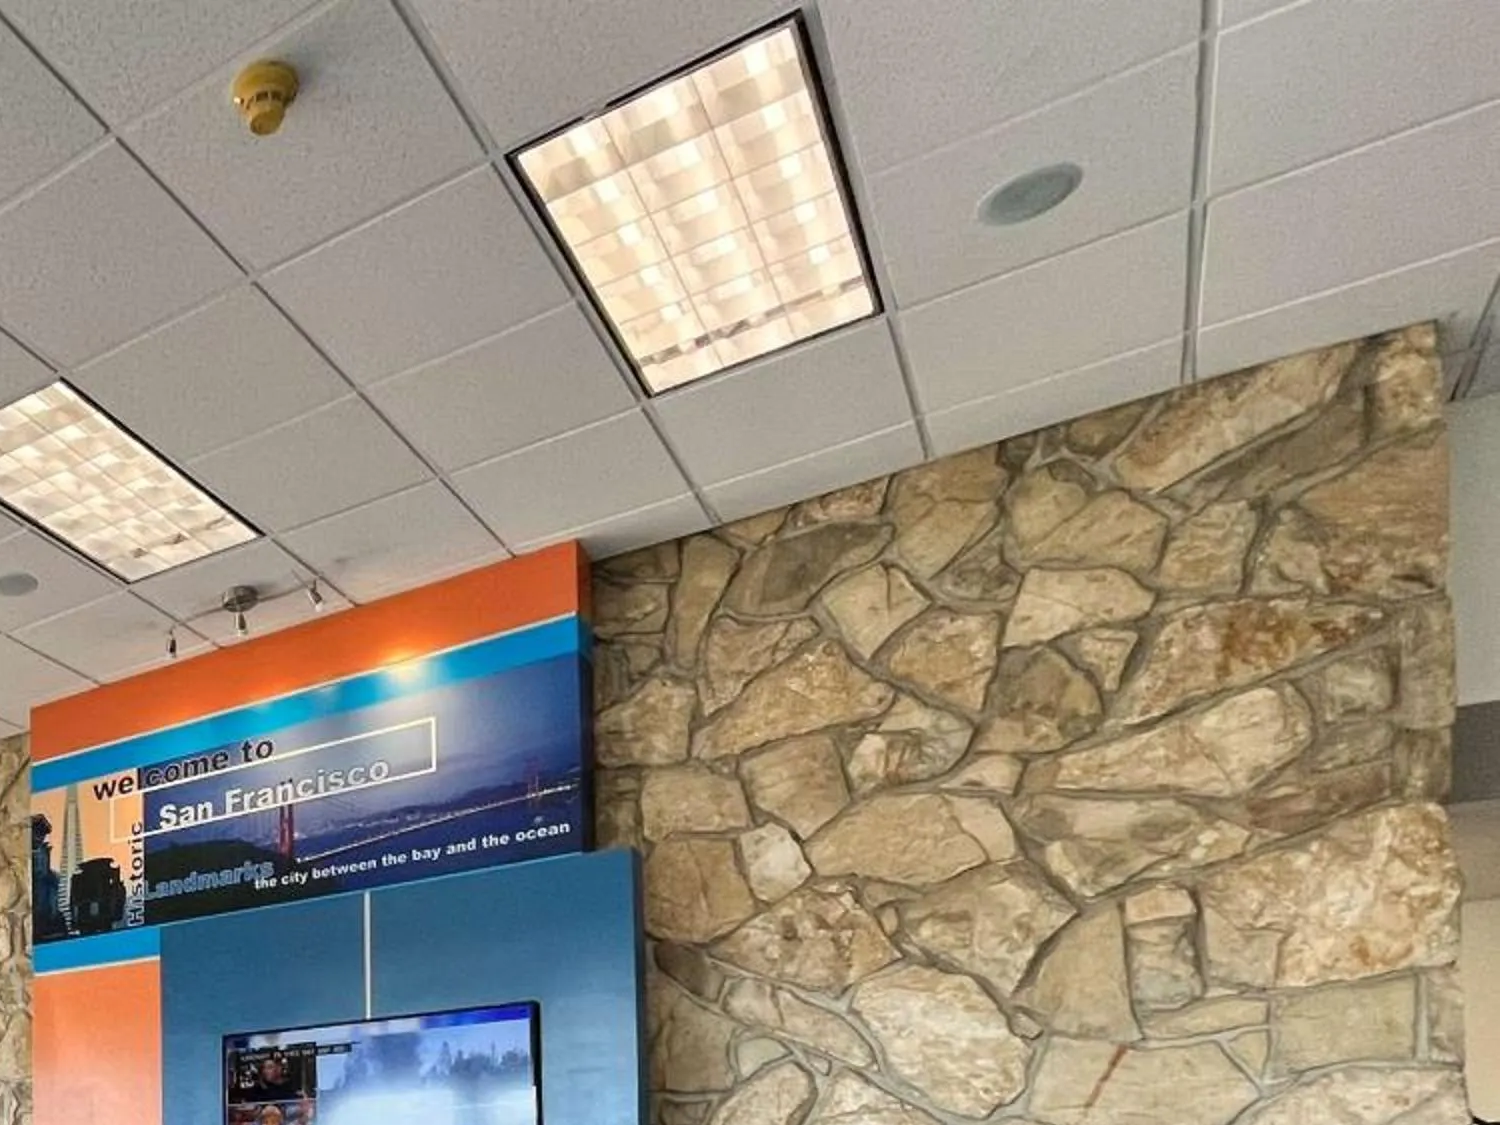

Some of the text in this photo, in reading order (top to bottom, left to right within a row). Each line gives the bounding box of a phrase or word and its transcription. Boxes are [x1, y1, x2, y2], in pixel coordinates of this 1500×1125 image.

[94, 739, 274, 801] welcome to
[159, 760, 389, 831] San Francisco
[127, 822, 145, 927] Historic
[144, 861, 274, 901] Landmarks
[255, 822, 571, 890] the city between the bay and the ocean
